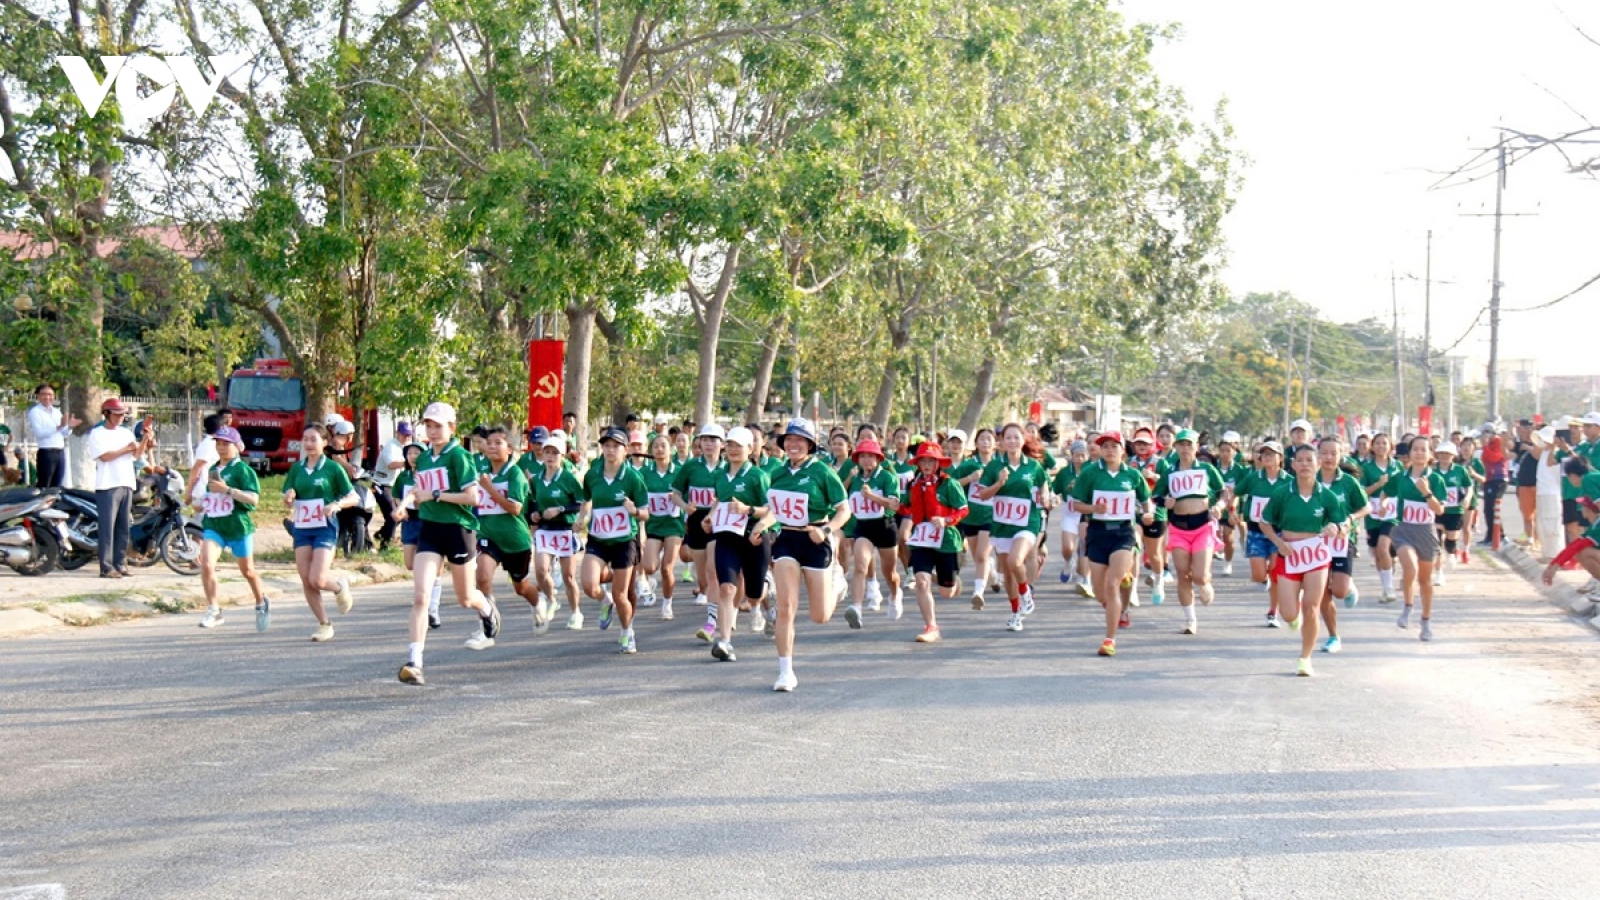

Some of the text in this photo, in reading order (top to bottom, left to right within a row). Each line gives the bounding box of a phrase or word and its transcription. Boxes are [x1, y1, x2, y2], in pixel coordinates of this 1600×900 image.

[1171, 474, 1204, 494] 007
[203, 497, 232, 513] 216
[689, 488, 715, 507] 00
[771, 496, 805, 520] 145
[995, 501, 1027, 520] 019
[593, 512, 627, 534] 002
[540, 533, 570, 552] 142
[1288, 542, 1328, 567] 006
